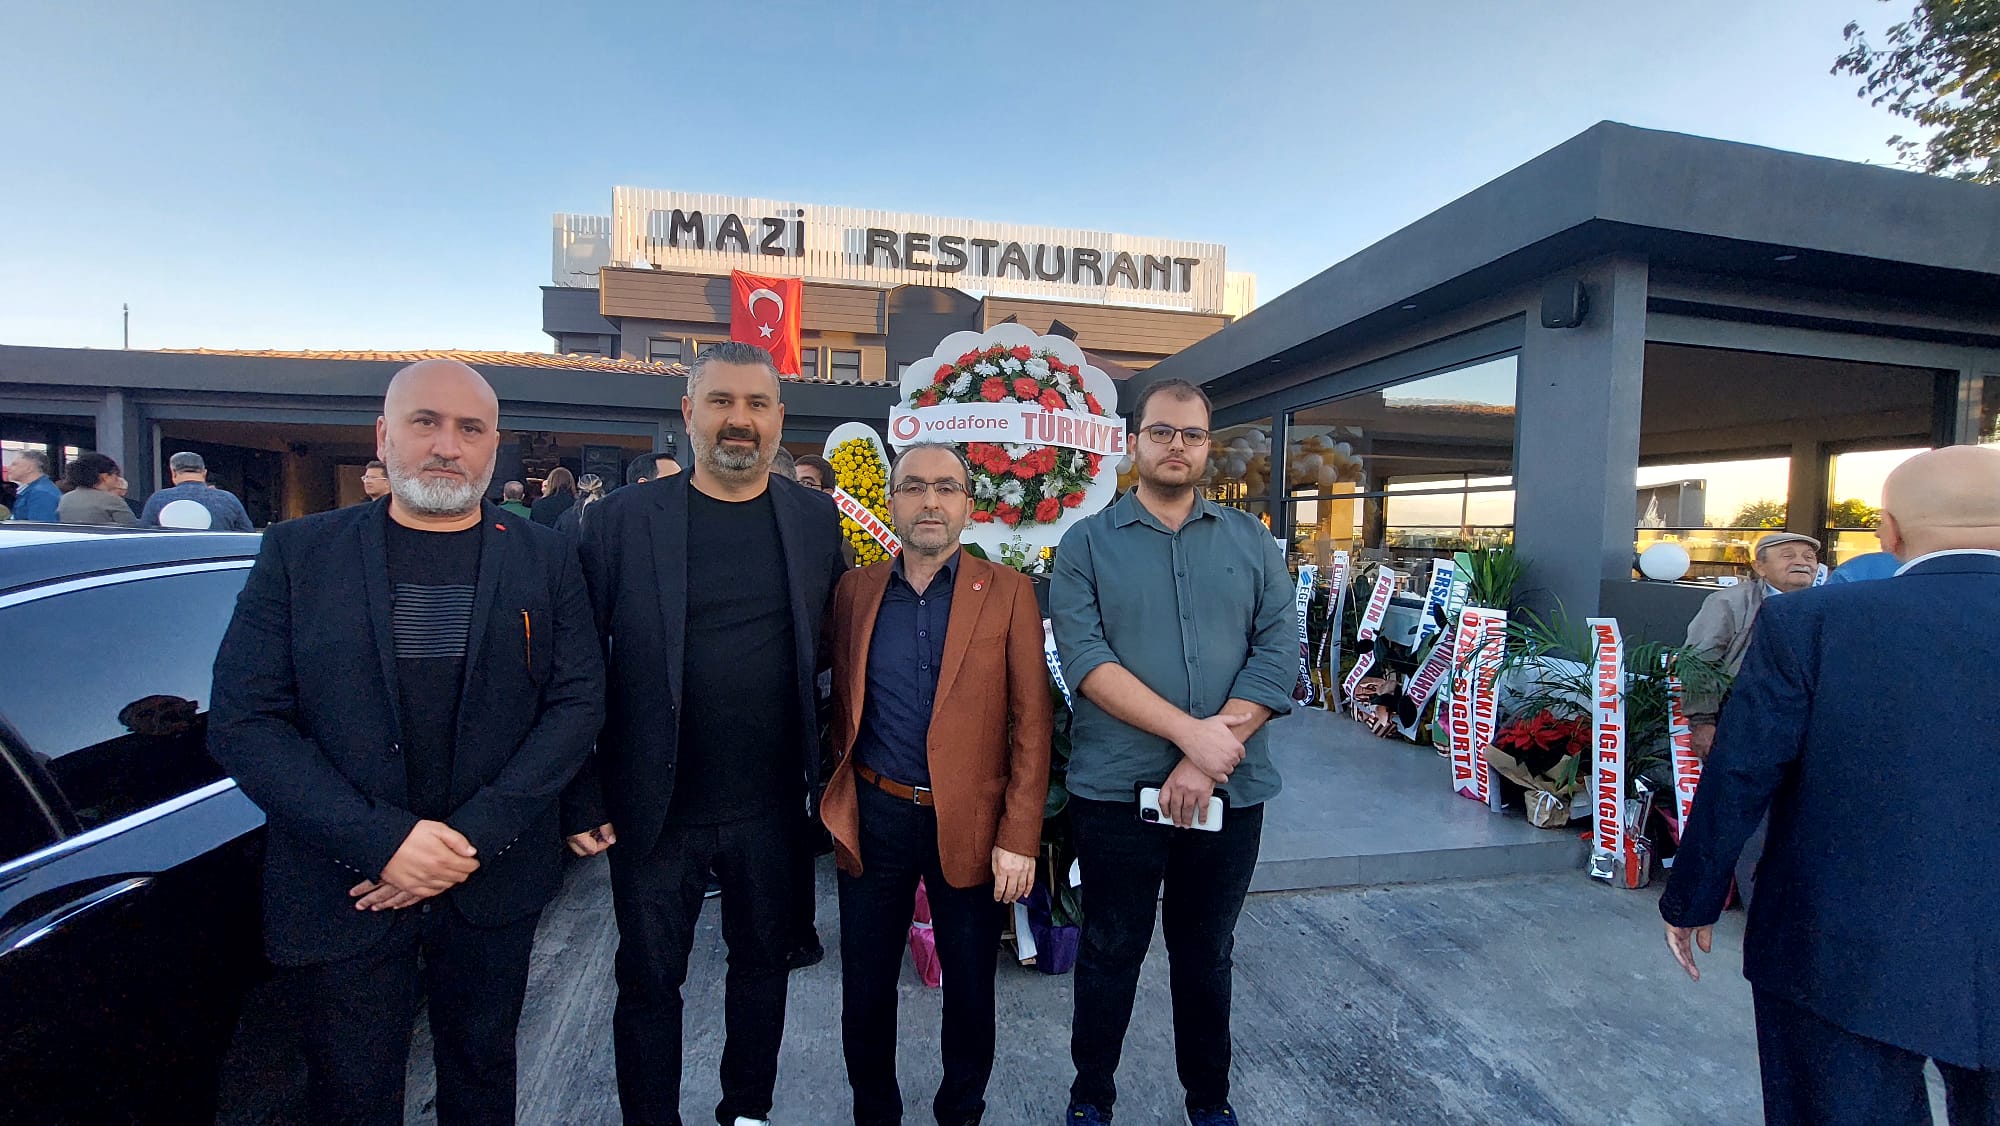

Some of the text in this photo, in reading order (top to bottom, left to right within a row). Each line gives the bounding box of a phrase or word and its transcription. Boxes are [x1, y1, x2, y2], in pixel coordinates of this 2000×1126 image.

[866, 227, 1200, 293] RESTAURANT
[924, 409, 1124, 453] vodafone TÜRKİYE
[1297, 586, 1310, 609] EGE
[1452, 677, 1474, 780] SİGORTA
[1599, 768, 1620, 852] AKGÜN
